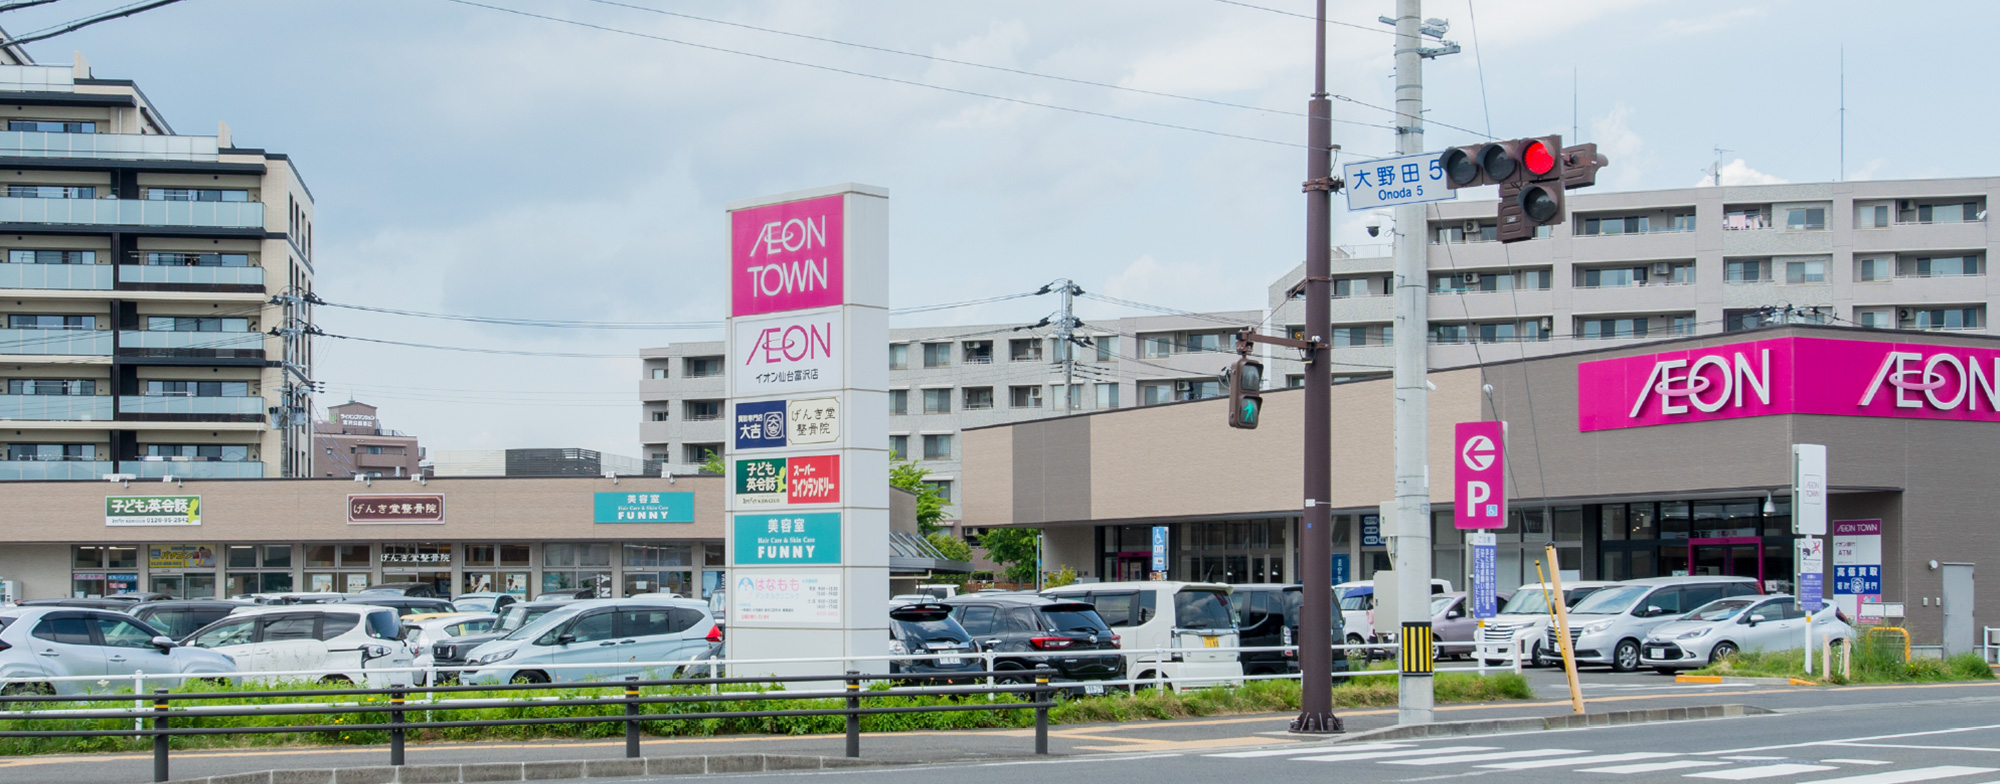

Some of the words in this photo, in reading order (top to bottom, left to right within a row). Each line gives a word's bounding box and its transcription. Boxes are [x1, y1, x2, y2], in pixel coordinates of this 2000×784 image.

[1353, 163, 1420, 190] 大野田
[1429, 159, 1443, 180] 5
[1378, 186, 1412, 201] Onoda
[1416, 187, 1424, 196] 5
[747, 257, 827, 298] TOWN
[755, 368, 819, 383] イオン仙台富沢店
[791, 407, 836, 422] げんき堂
[740, 423, 762, 439] 大吉
[796, 422, 831, 436] 整骨院
[746, 461, 776, 476] 子ども
[793, 463, 816, 477] スーパー
[746, 476, 776, 492] 英会話
[792, 477, 835, 498] コインランドリー
[111, 498, 188, 513] 子ども英会話
[627, 494, 660, 504] 美容室
[1467, 481, 1491, 517] P
[353, 503, 438, 515] げんき堂整骨院
[618, 511, 669, 520] FUNNY
[767, 518, 805, 533] 美容室
[380, 553, 451, 562] げんき堂整骨院
[757, 545, 816, 559] FUNNY
[1837, 566, 1878, 577] 高価買取
[755, 577, 800, 592] はなもも
